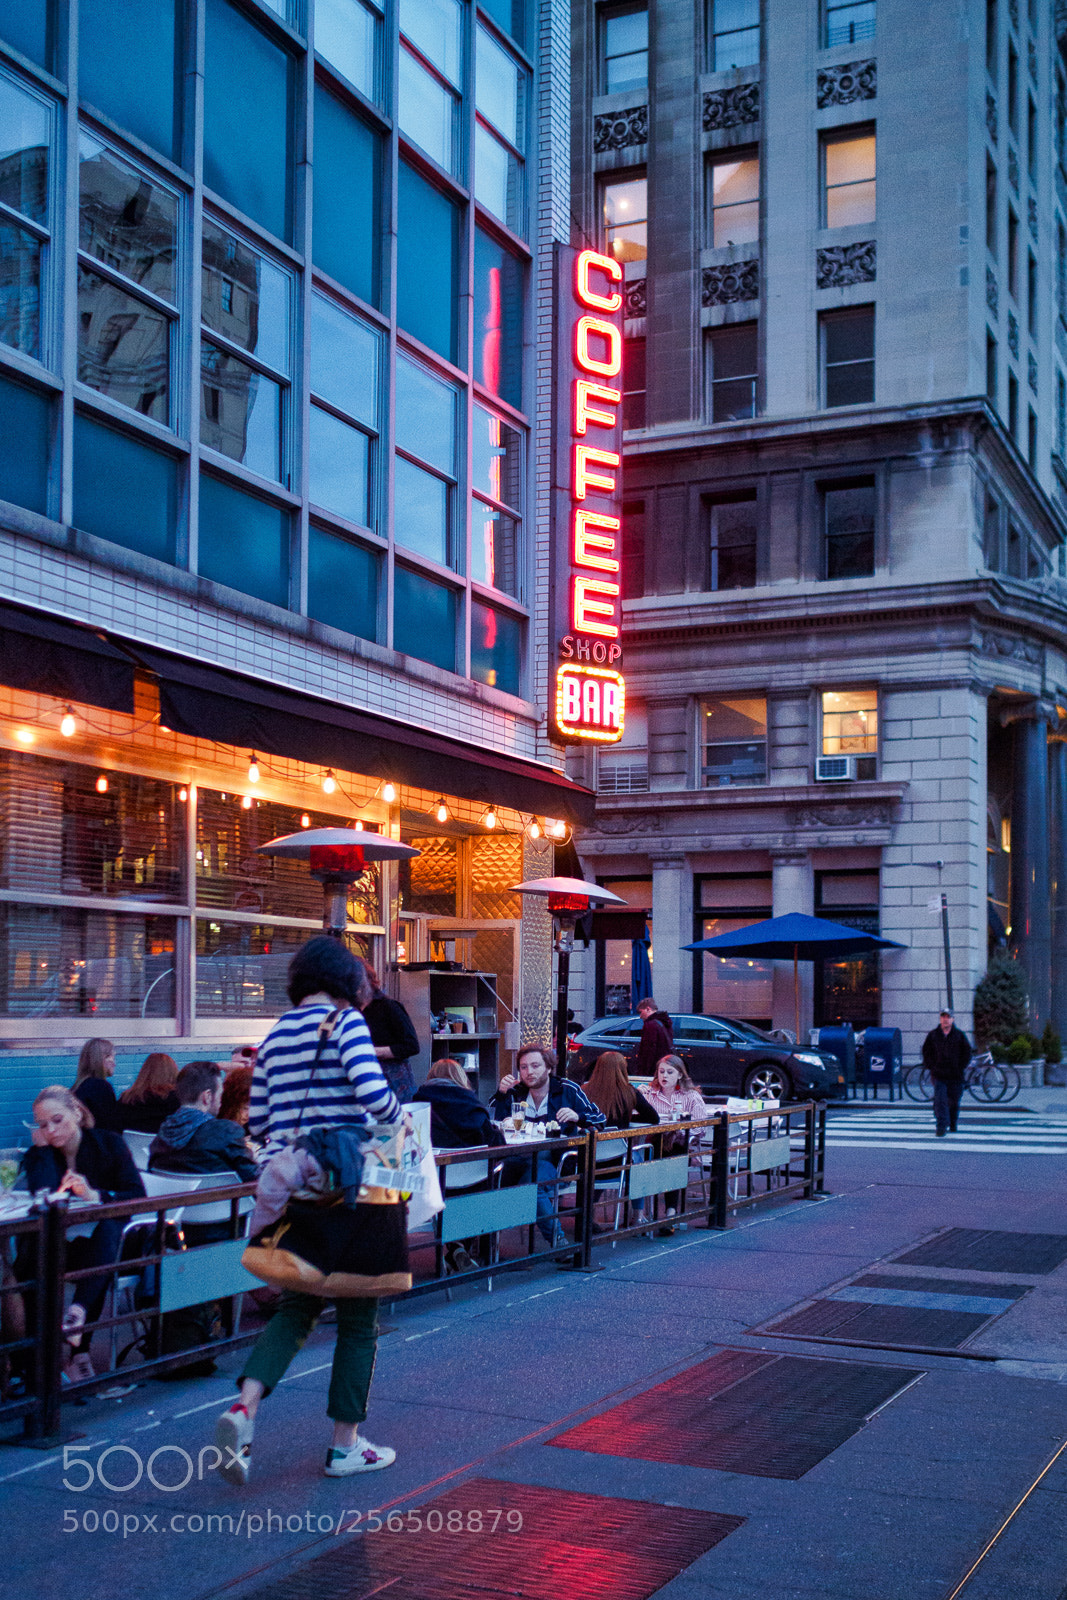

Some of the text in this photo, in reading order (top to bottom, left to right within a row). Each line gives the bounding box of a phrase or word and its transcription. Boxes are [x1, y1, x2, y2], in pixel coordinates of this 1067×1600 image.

[573, 248, 624, 639] COFFEE
[561, 635, 622, 664] SHOP
[561, 676, 621, 729] BAR
